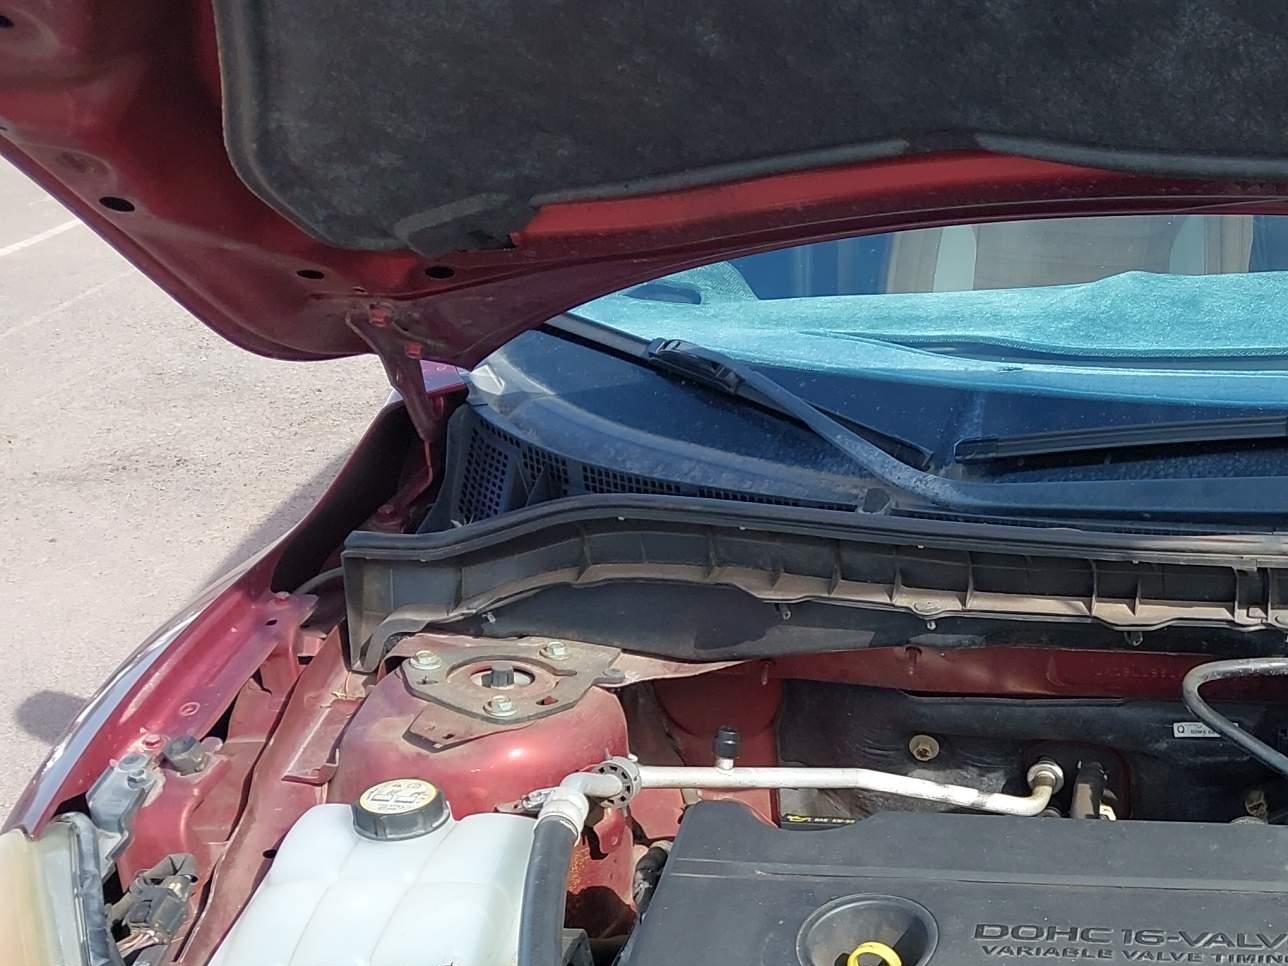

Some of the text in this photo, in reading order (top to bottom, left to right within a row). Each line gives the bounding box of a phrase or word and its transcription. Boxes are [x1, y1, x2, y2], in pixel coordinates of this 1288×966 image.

[974, 923, 1114, 944] DOHC
[981, 945, 1114, 960] VARIABLE
[1121, 950, 1203, 963] VALVE
